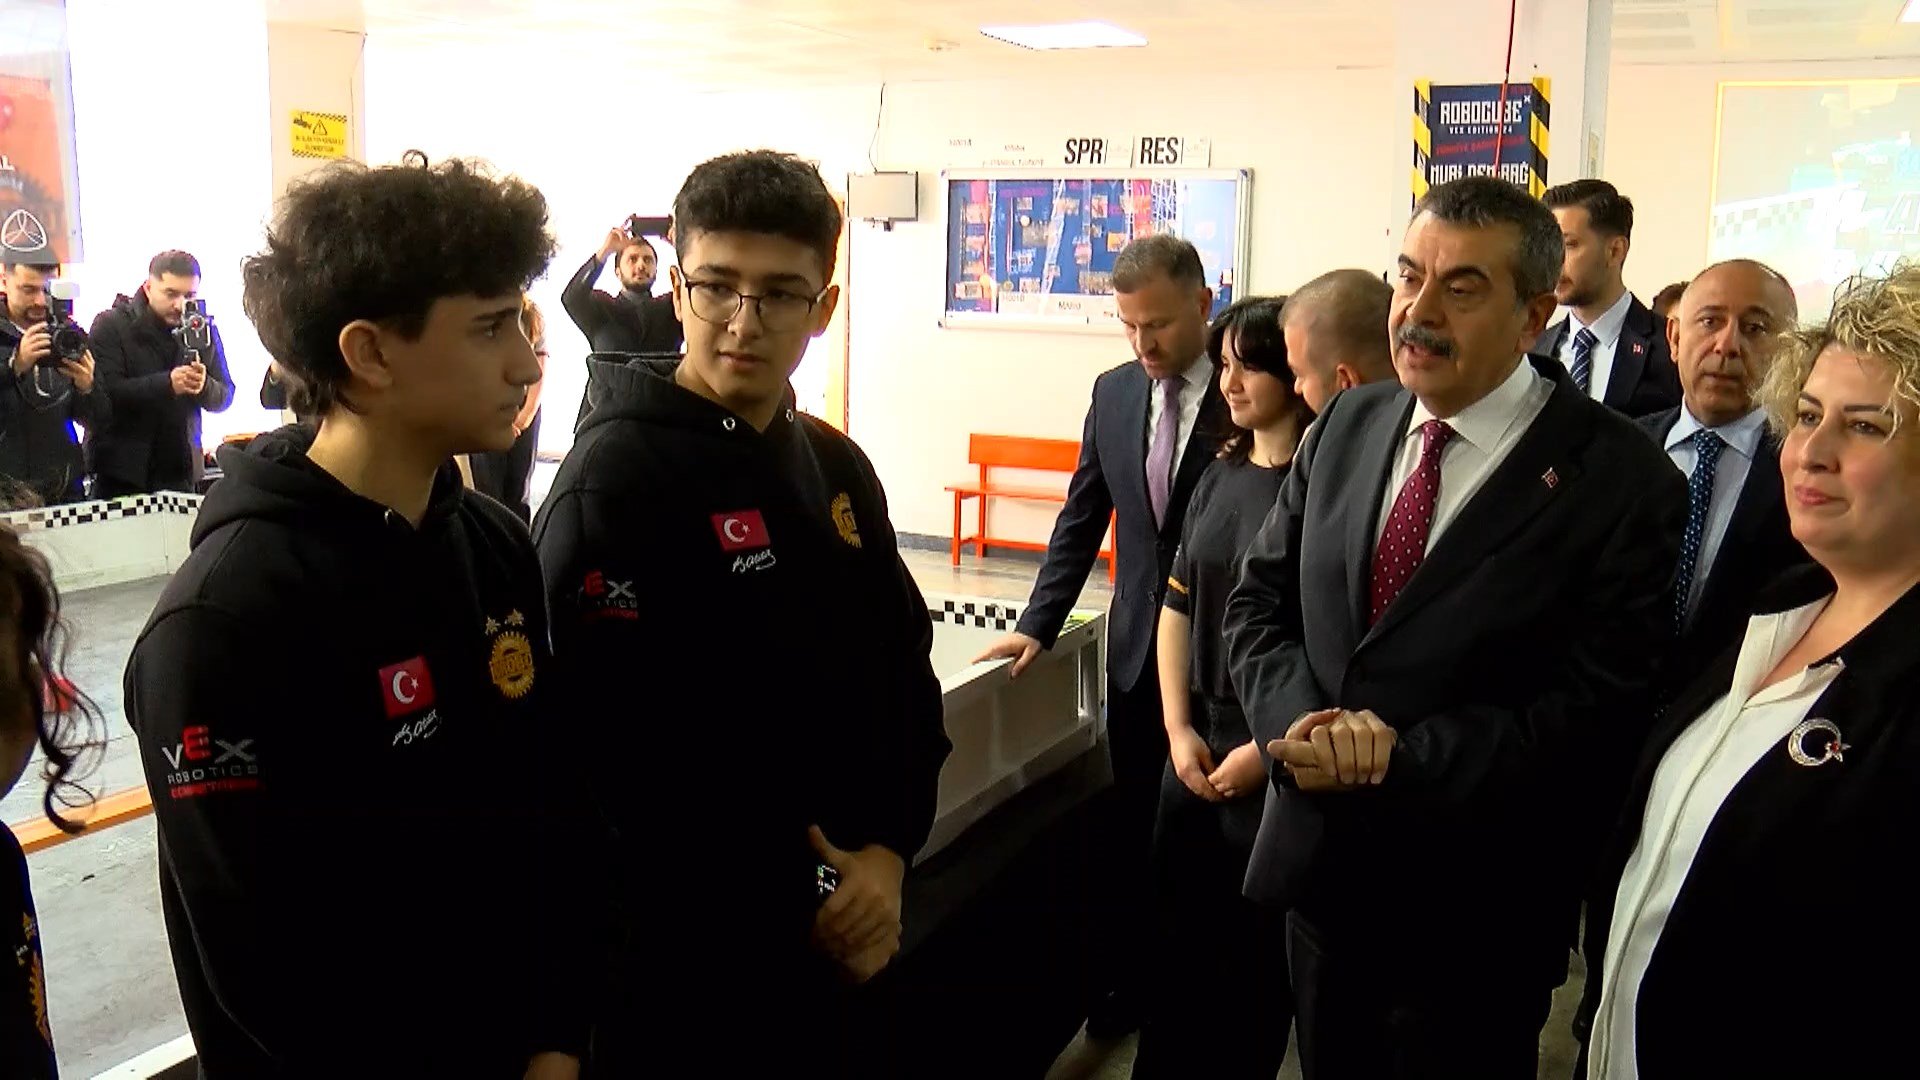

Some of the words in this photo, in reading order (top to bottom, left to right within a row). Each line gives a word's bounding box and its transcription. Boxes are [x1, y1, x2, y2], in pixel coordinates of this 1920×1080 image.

[1440, 100, 1522, 124] ROBOCUBE
[1064, 137, 1103, 165] SPR
[1140, 136, 1179, 165] RES
[161, 723, 257, 770] VEX
[166, 764, 260, 785] ROBOTICS
